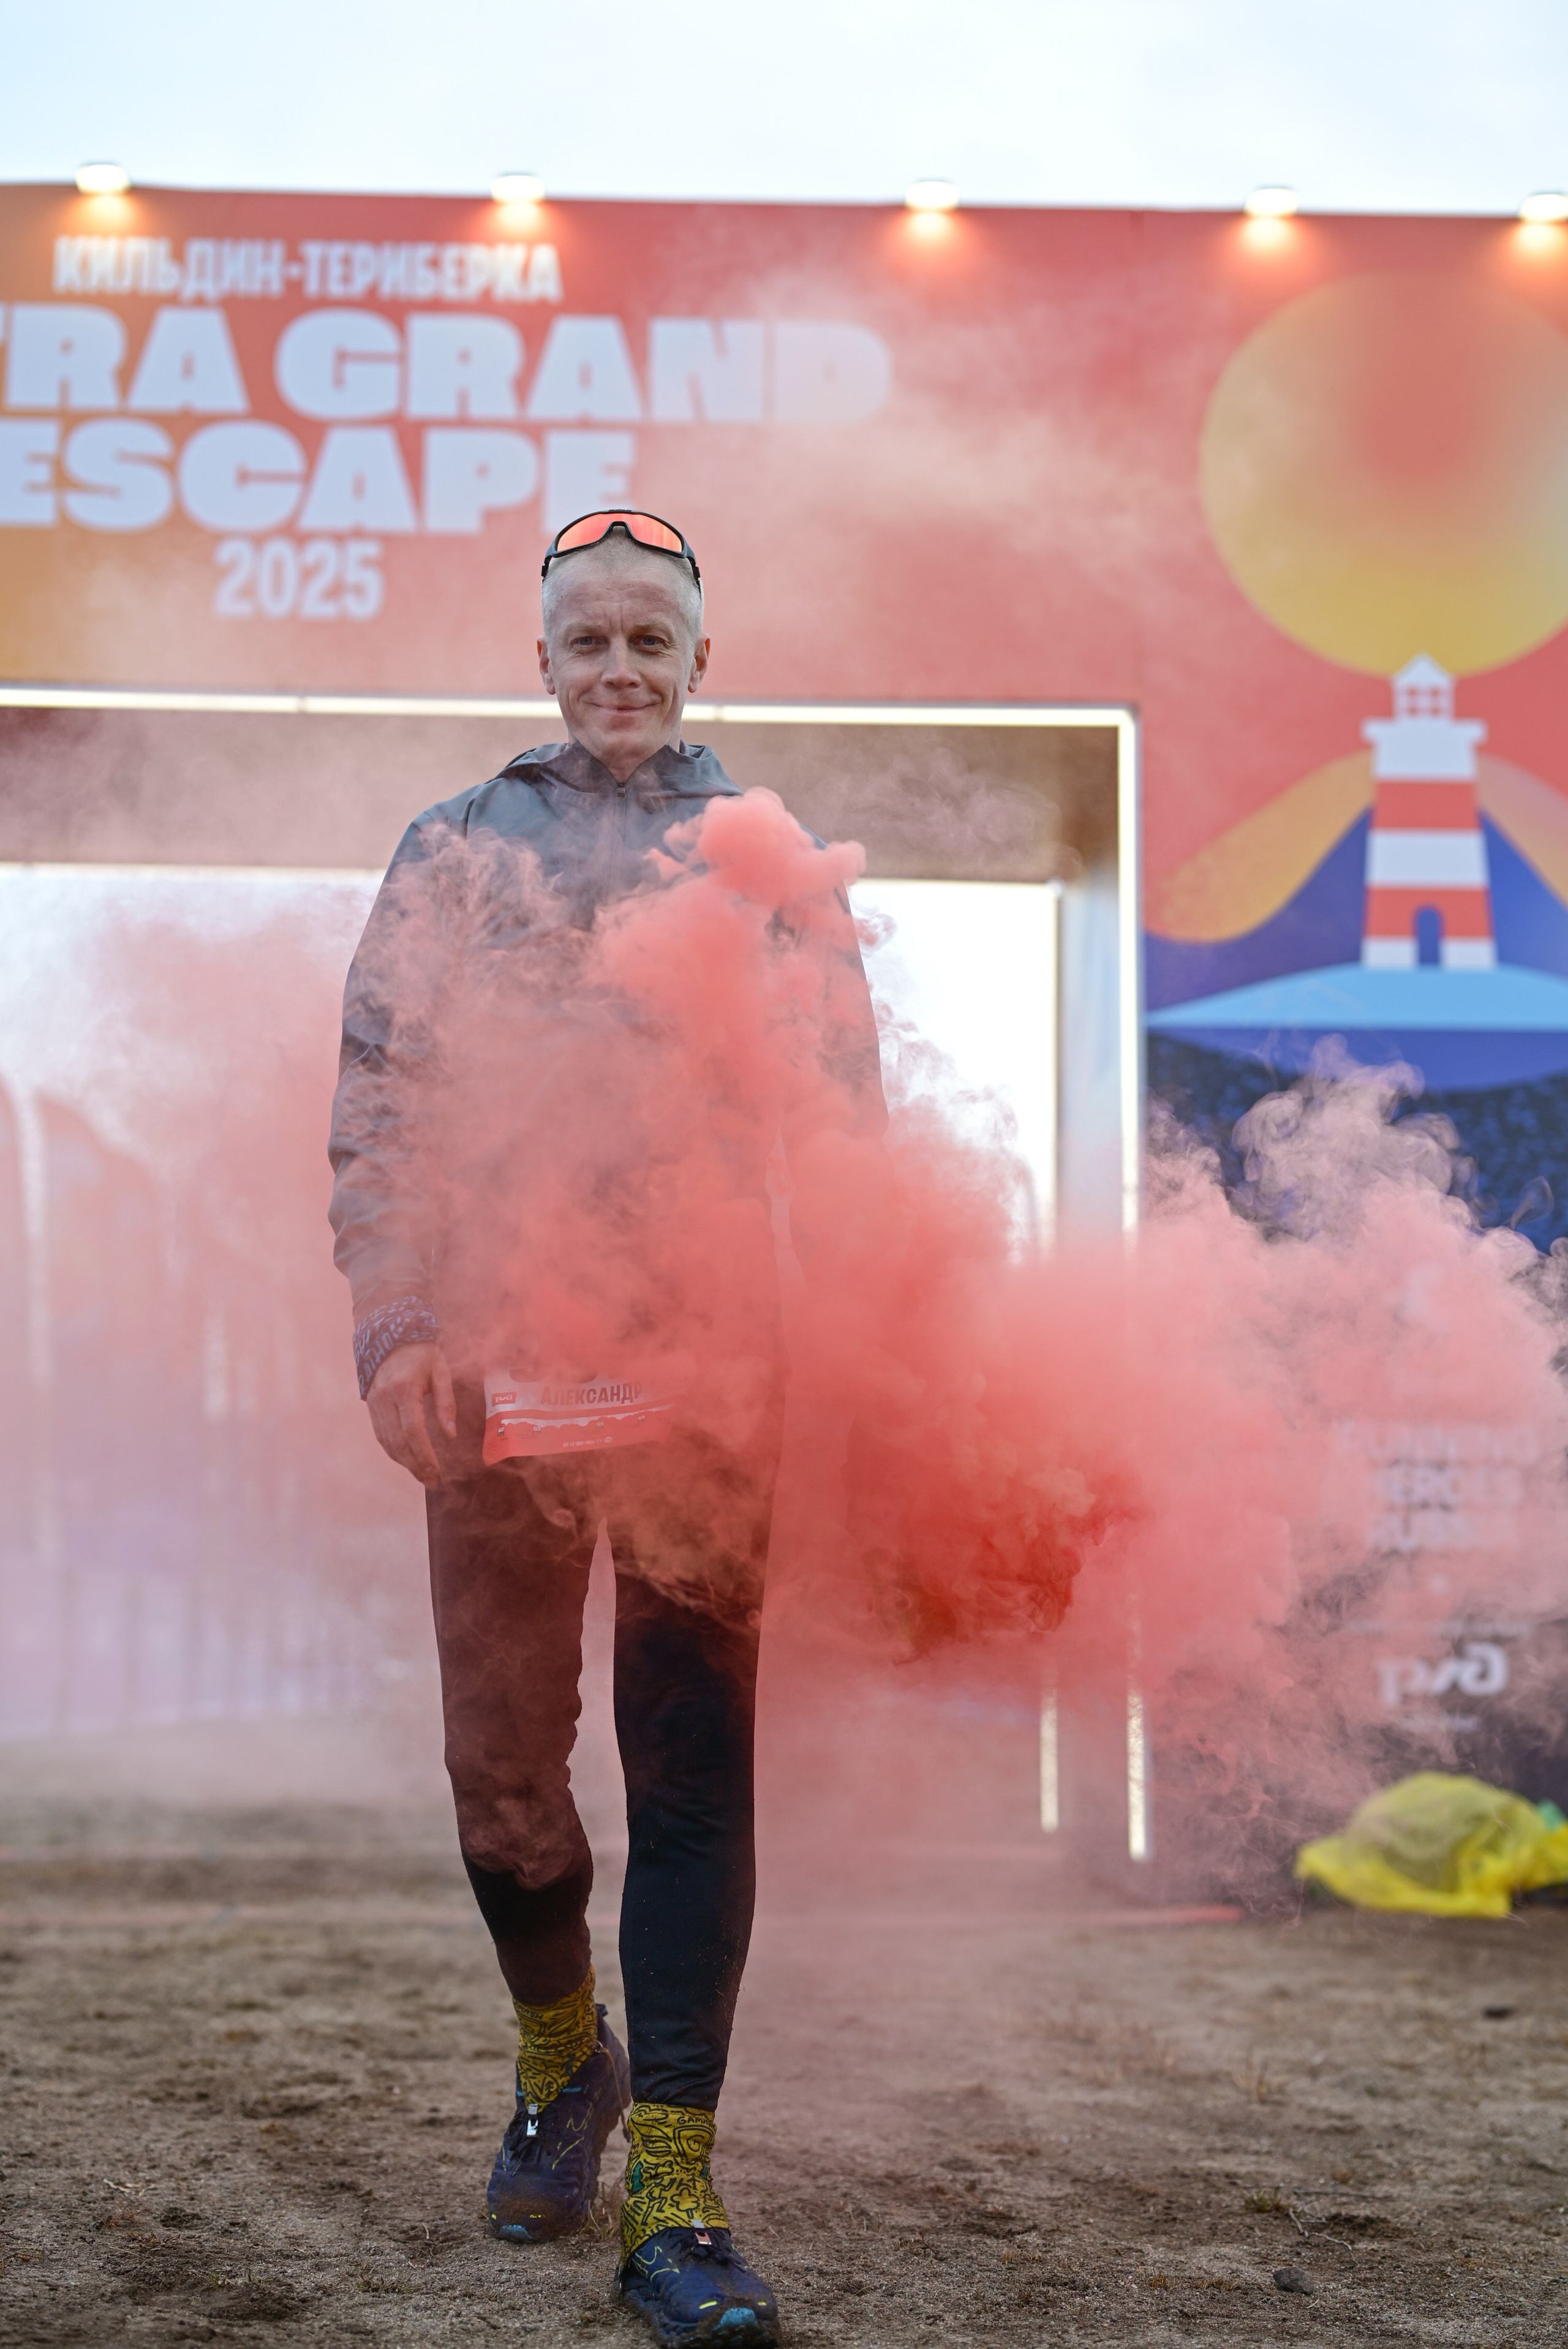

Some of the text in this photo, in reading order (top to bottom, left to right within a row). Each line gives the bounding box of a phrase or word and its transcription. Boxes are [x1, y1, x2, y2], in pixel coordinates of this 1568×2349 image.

[53, 235, 564, 304] КИЛЬДИН-ТЕРИБЕРКА
[0, 303, 894, 423] RA GRAND
[214, 537, 385, 619] 2025
[540, 1381, 642, 1406] АЛЕКСАНДР
